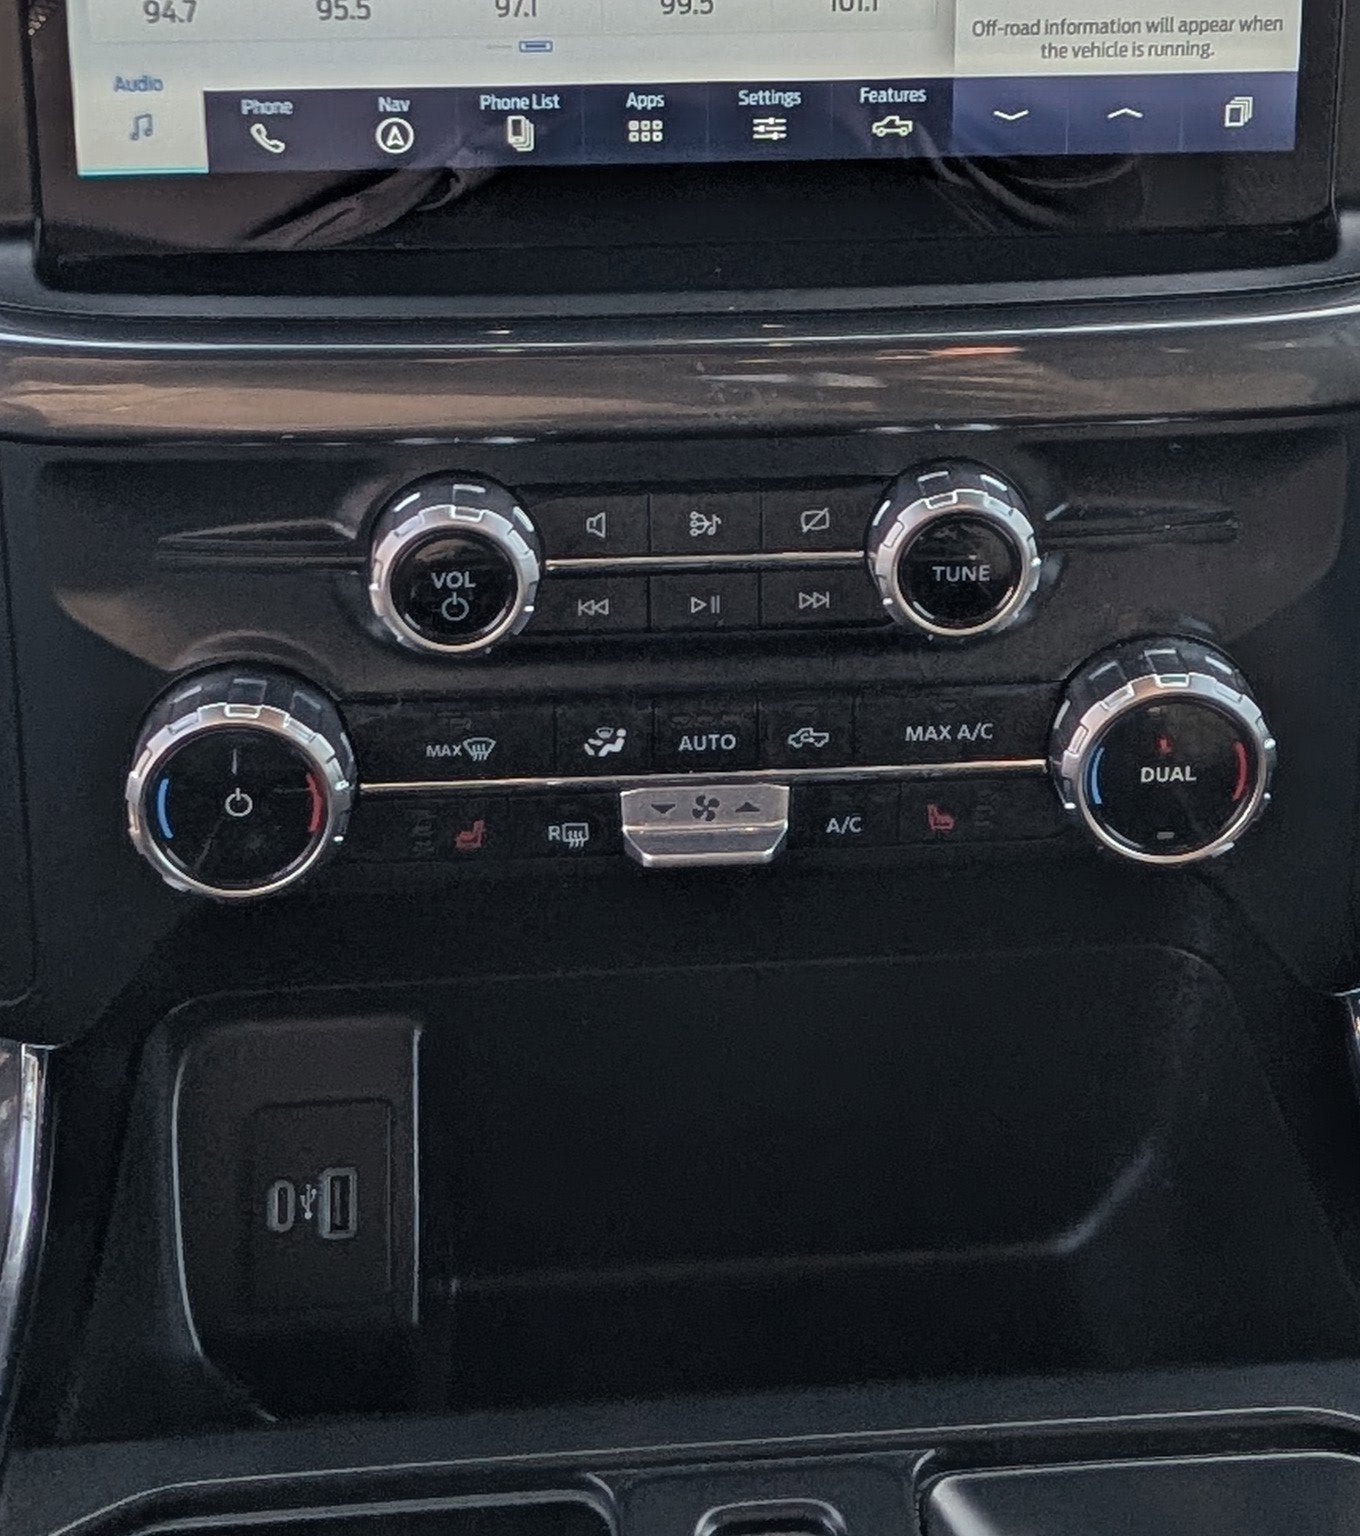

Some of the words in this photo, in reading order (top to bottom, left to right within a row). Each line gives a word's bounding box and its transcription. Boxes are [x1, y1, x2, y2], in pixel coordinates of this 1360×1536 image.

[143, 0, 196, 23] 94.7
[972, 19, 1040, 37] Off-road
[1045, 18, 1141, 35] information
[1146, 17, 1174, 33] will
[1178, 20, 1235, 35] appear
[1239, 15, 1283, 31] when
[1041, 42, 1068, 58] the
[1072, 41, 1128, 58] vehicle
[1132, 41, 1144, 57] is
[1148, 40, 1214, 59] running.
[114, 75, 163, 92] Audio
[480, 95, 529, 110] Phone
[532, 94, 559, 109] List
[626, 92, 664, 110] Apps
[739, 90, 801, 107] Settings
[860, 87, 926, 103] Features
[241, 99, 293, 114] Phone
[379, 97, 410, 112] Nav
[432, 571, 476, 589] VOL
[933, 564, 990, 581] TUNE
[906, 725, 951, 741] MAX
[957, 723, 992, 740] A/C
[427, 745, 461, 757] MAX
[679, 734, 736, 751] AUTO
[1141, 766, 1196, 782] DUAL
[549, 826, 560, 840] R
[826, 817, 861, 834] A/C
